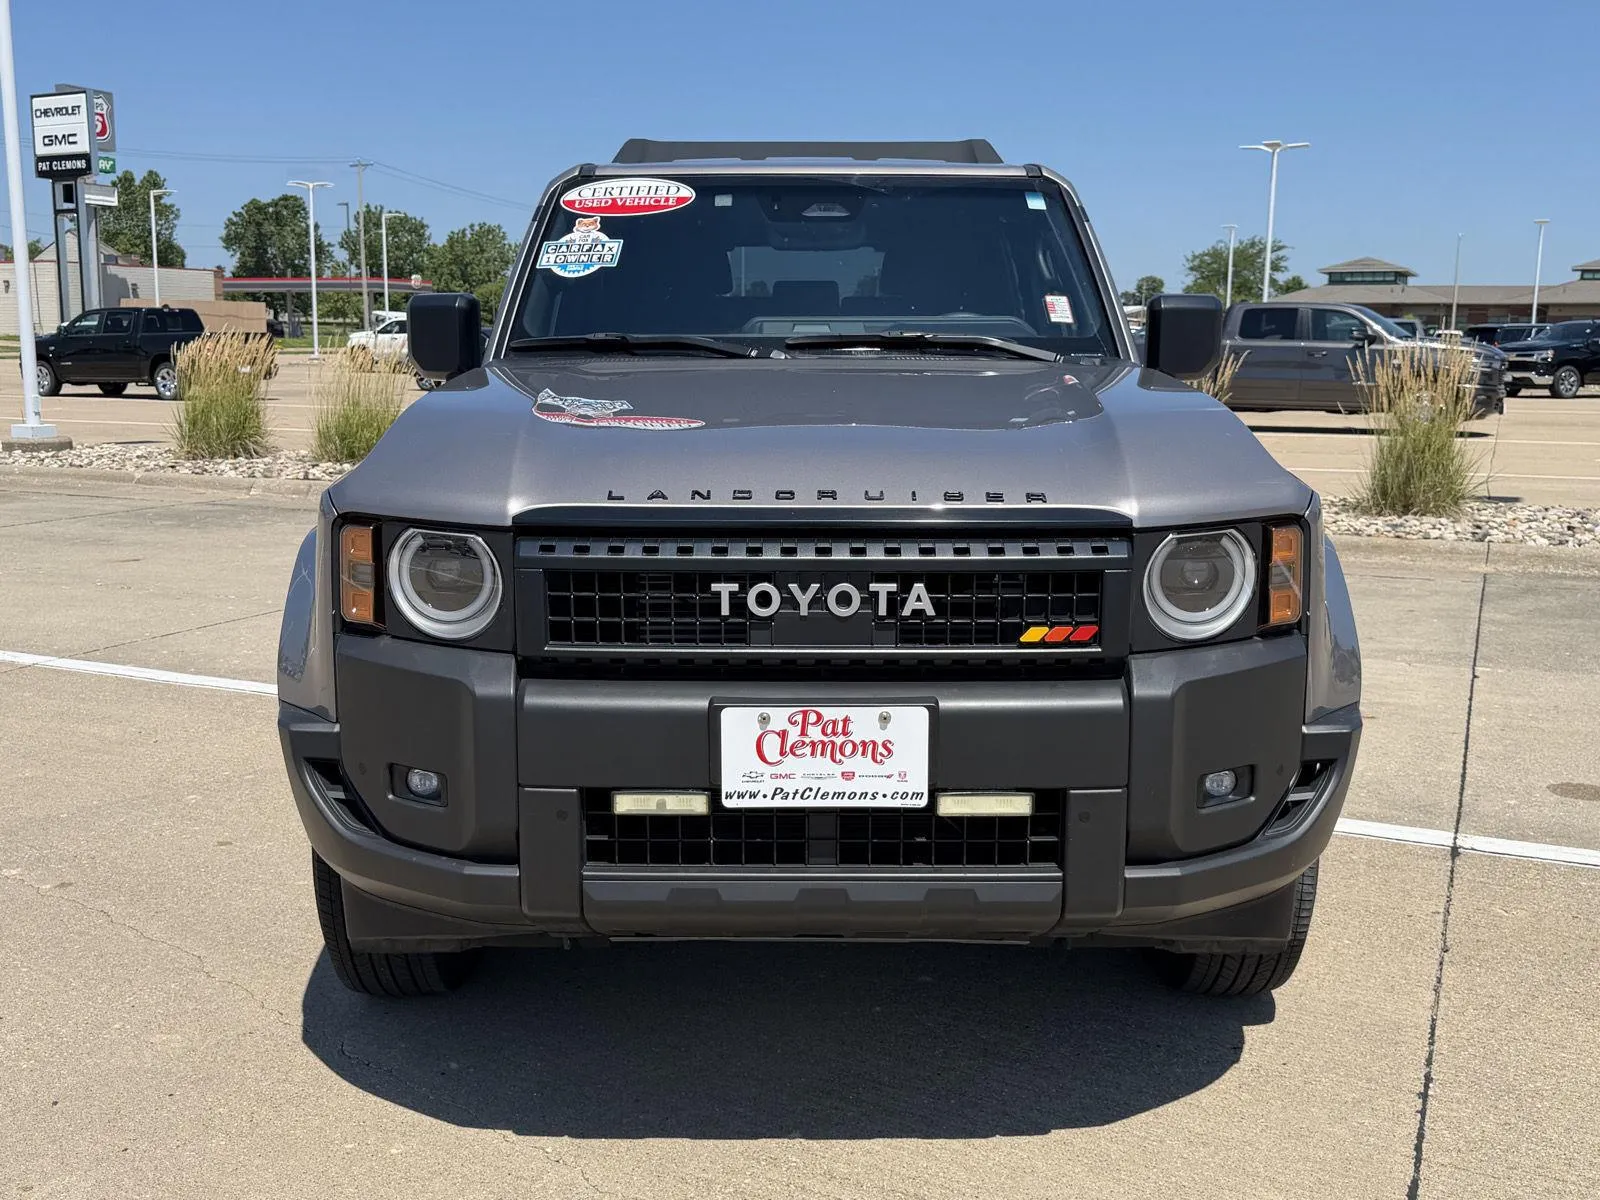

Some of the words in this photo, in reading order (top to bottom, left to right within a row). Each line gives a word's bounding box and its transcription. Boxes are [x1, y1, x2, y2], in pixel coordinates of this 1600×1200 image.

[34, 105, 82, 119] CHEVROLET
[42, 133, 78, 147] GMC
[38, 161, 51, 172] PAT
[52, 159, 87, 171] CLEMONS
[578, 185, 680, 199] CERTIFIED
[574, 198, 612, 208] USED
[615, 196, 677, 206] VEHICLE
[547, 243, 615, 254] CARFAX
[555, 254, 613, 263] OWNER
[710, 582, 936, 617] TOYOTA
[787, 709, 854, 739] Pat
[755, 728, 895, 767] Clemons
